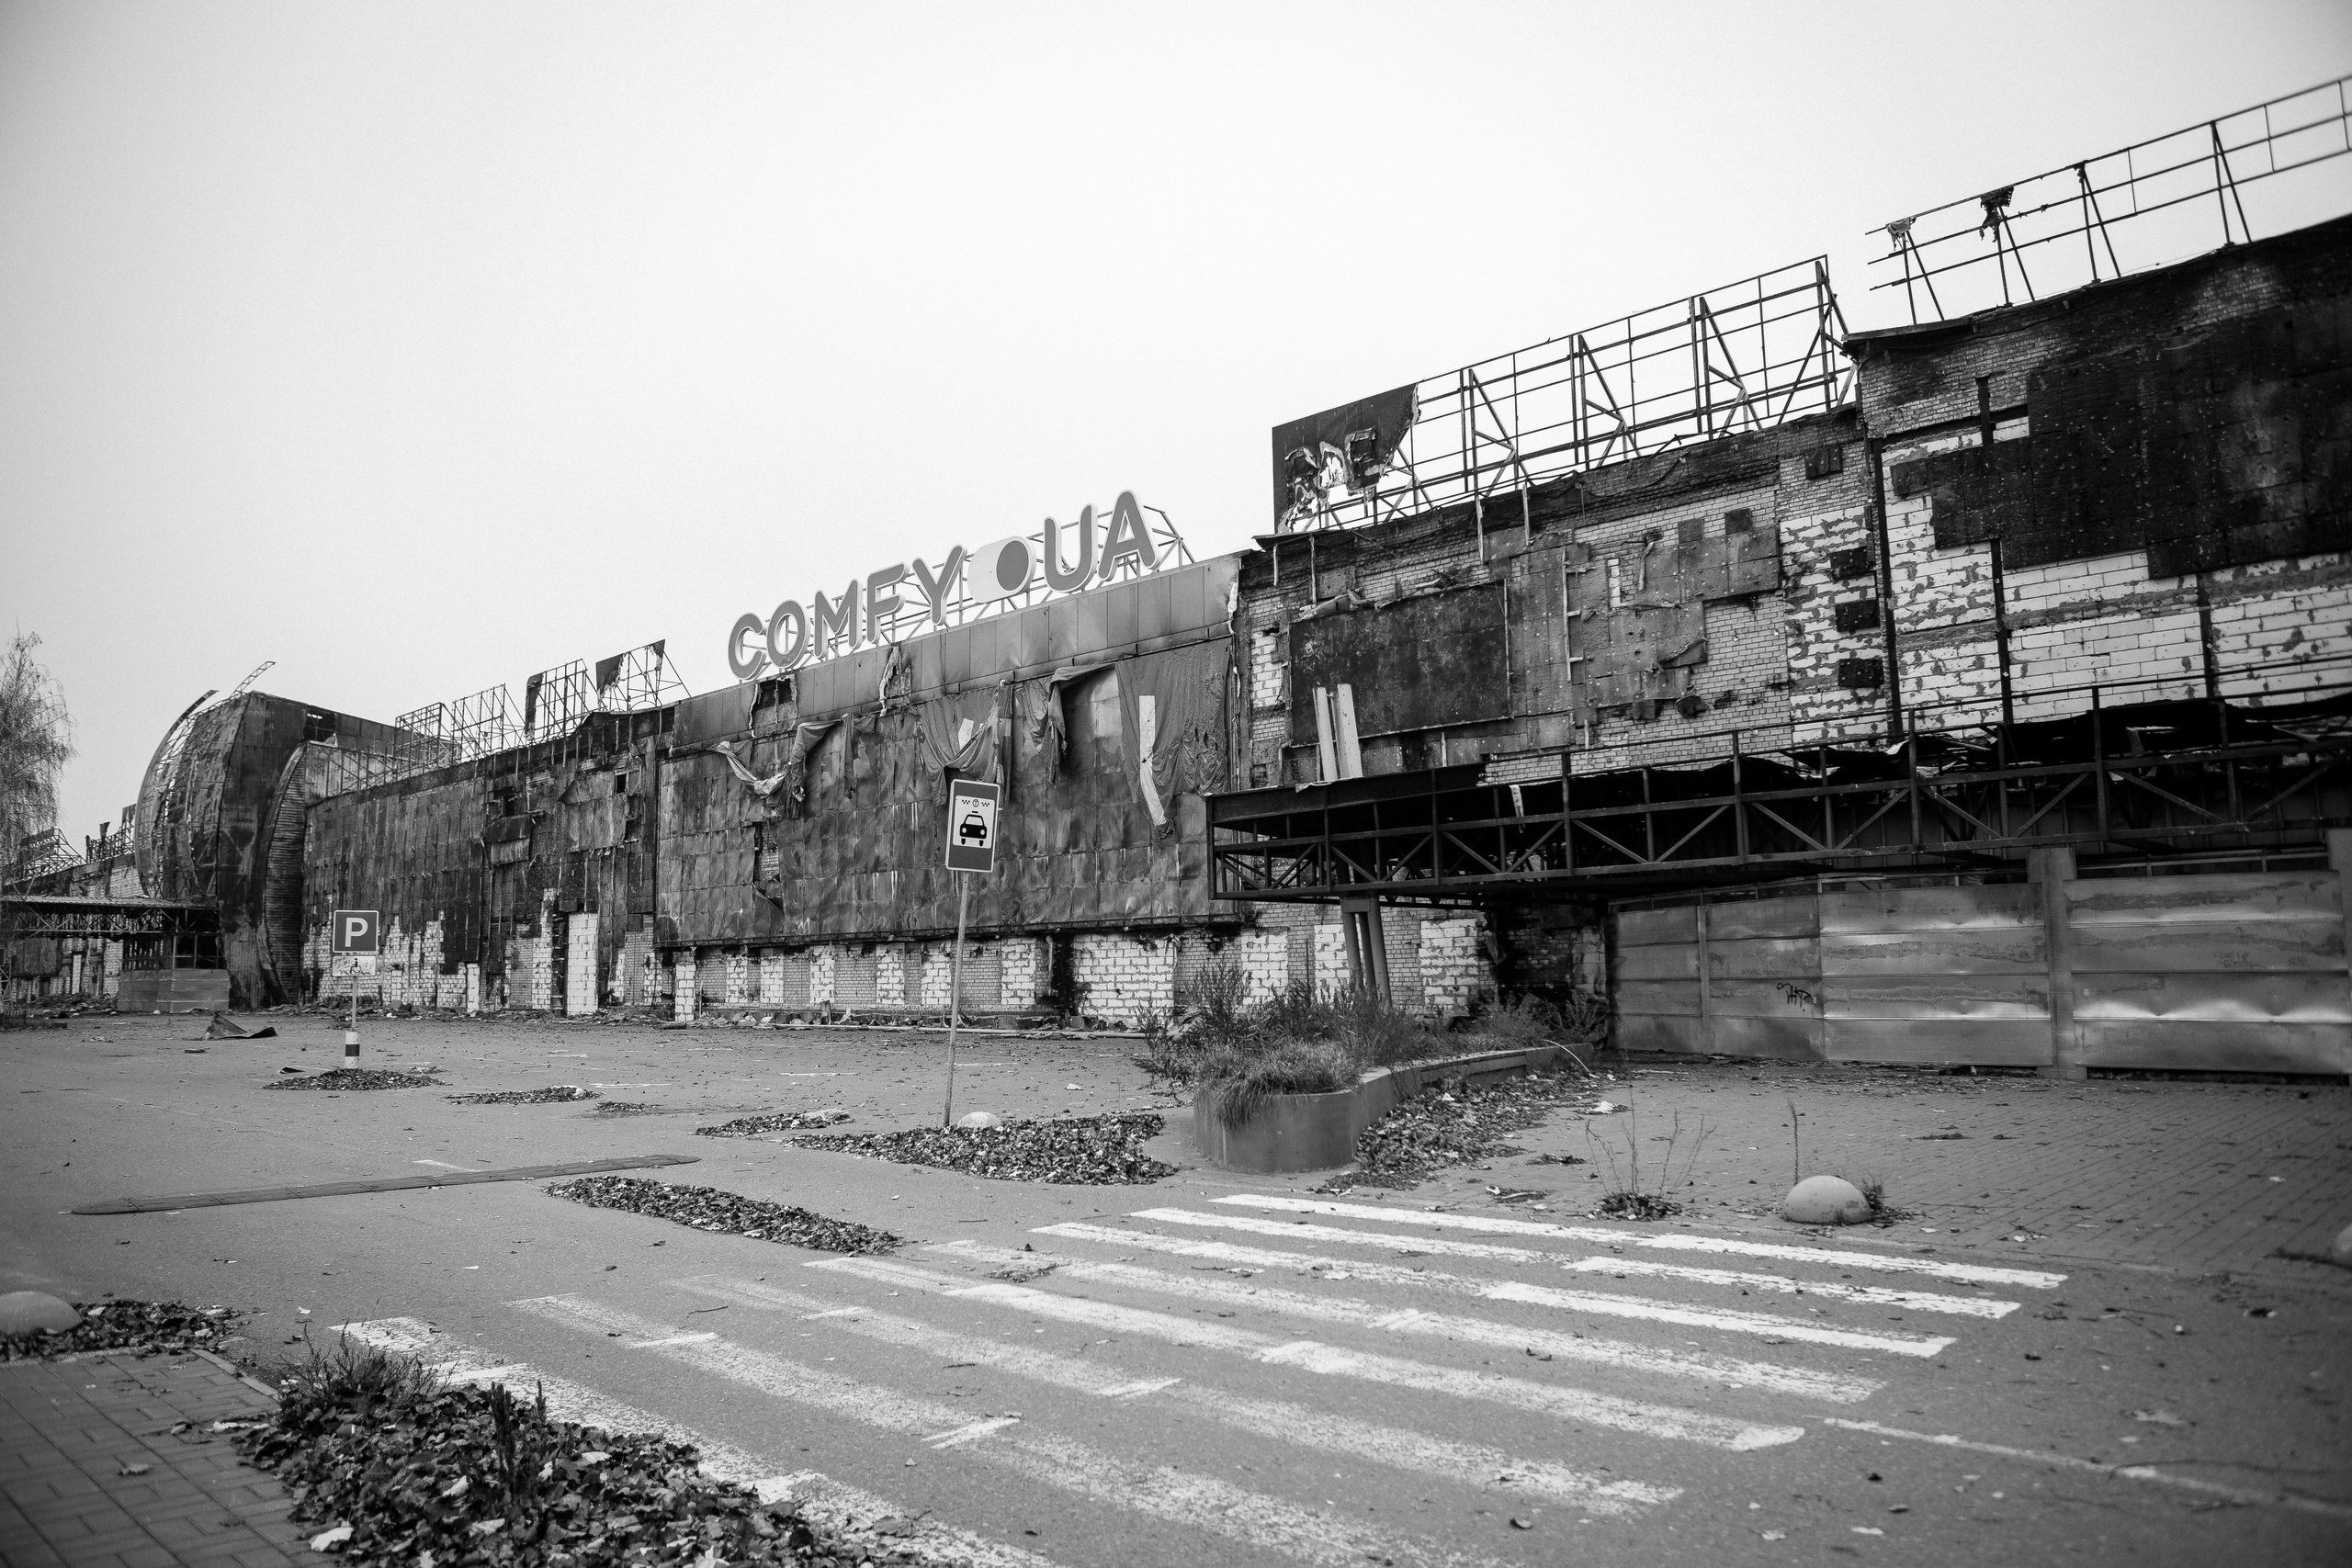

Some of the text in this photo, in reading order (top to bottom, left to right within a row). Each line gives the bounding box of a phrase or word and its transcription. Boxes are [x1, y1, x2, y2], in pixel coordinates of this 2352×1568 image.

[728, 490, 1161, 681] COMFY UA
[345, 918, 368, 947] P
